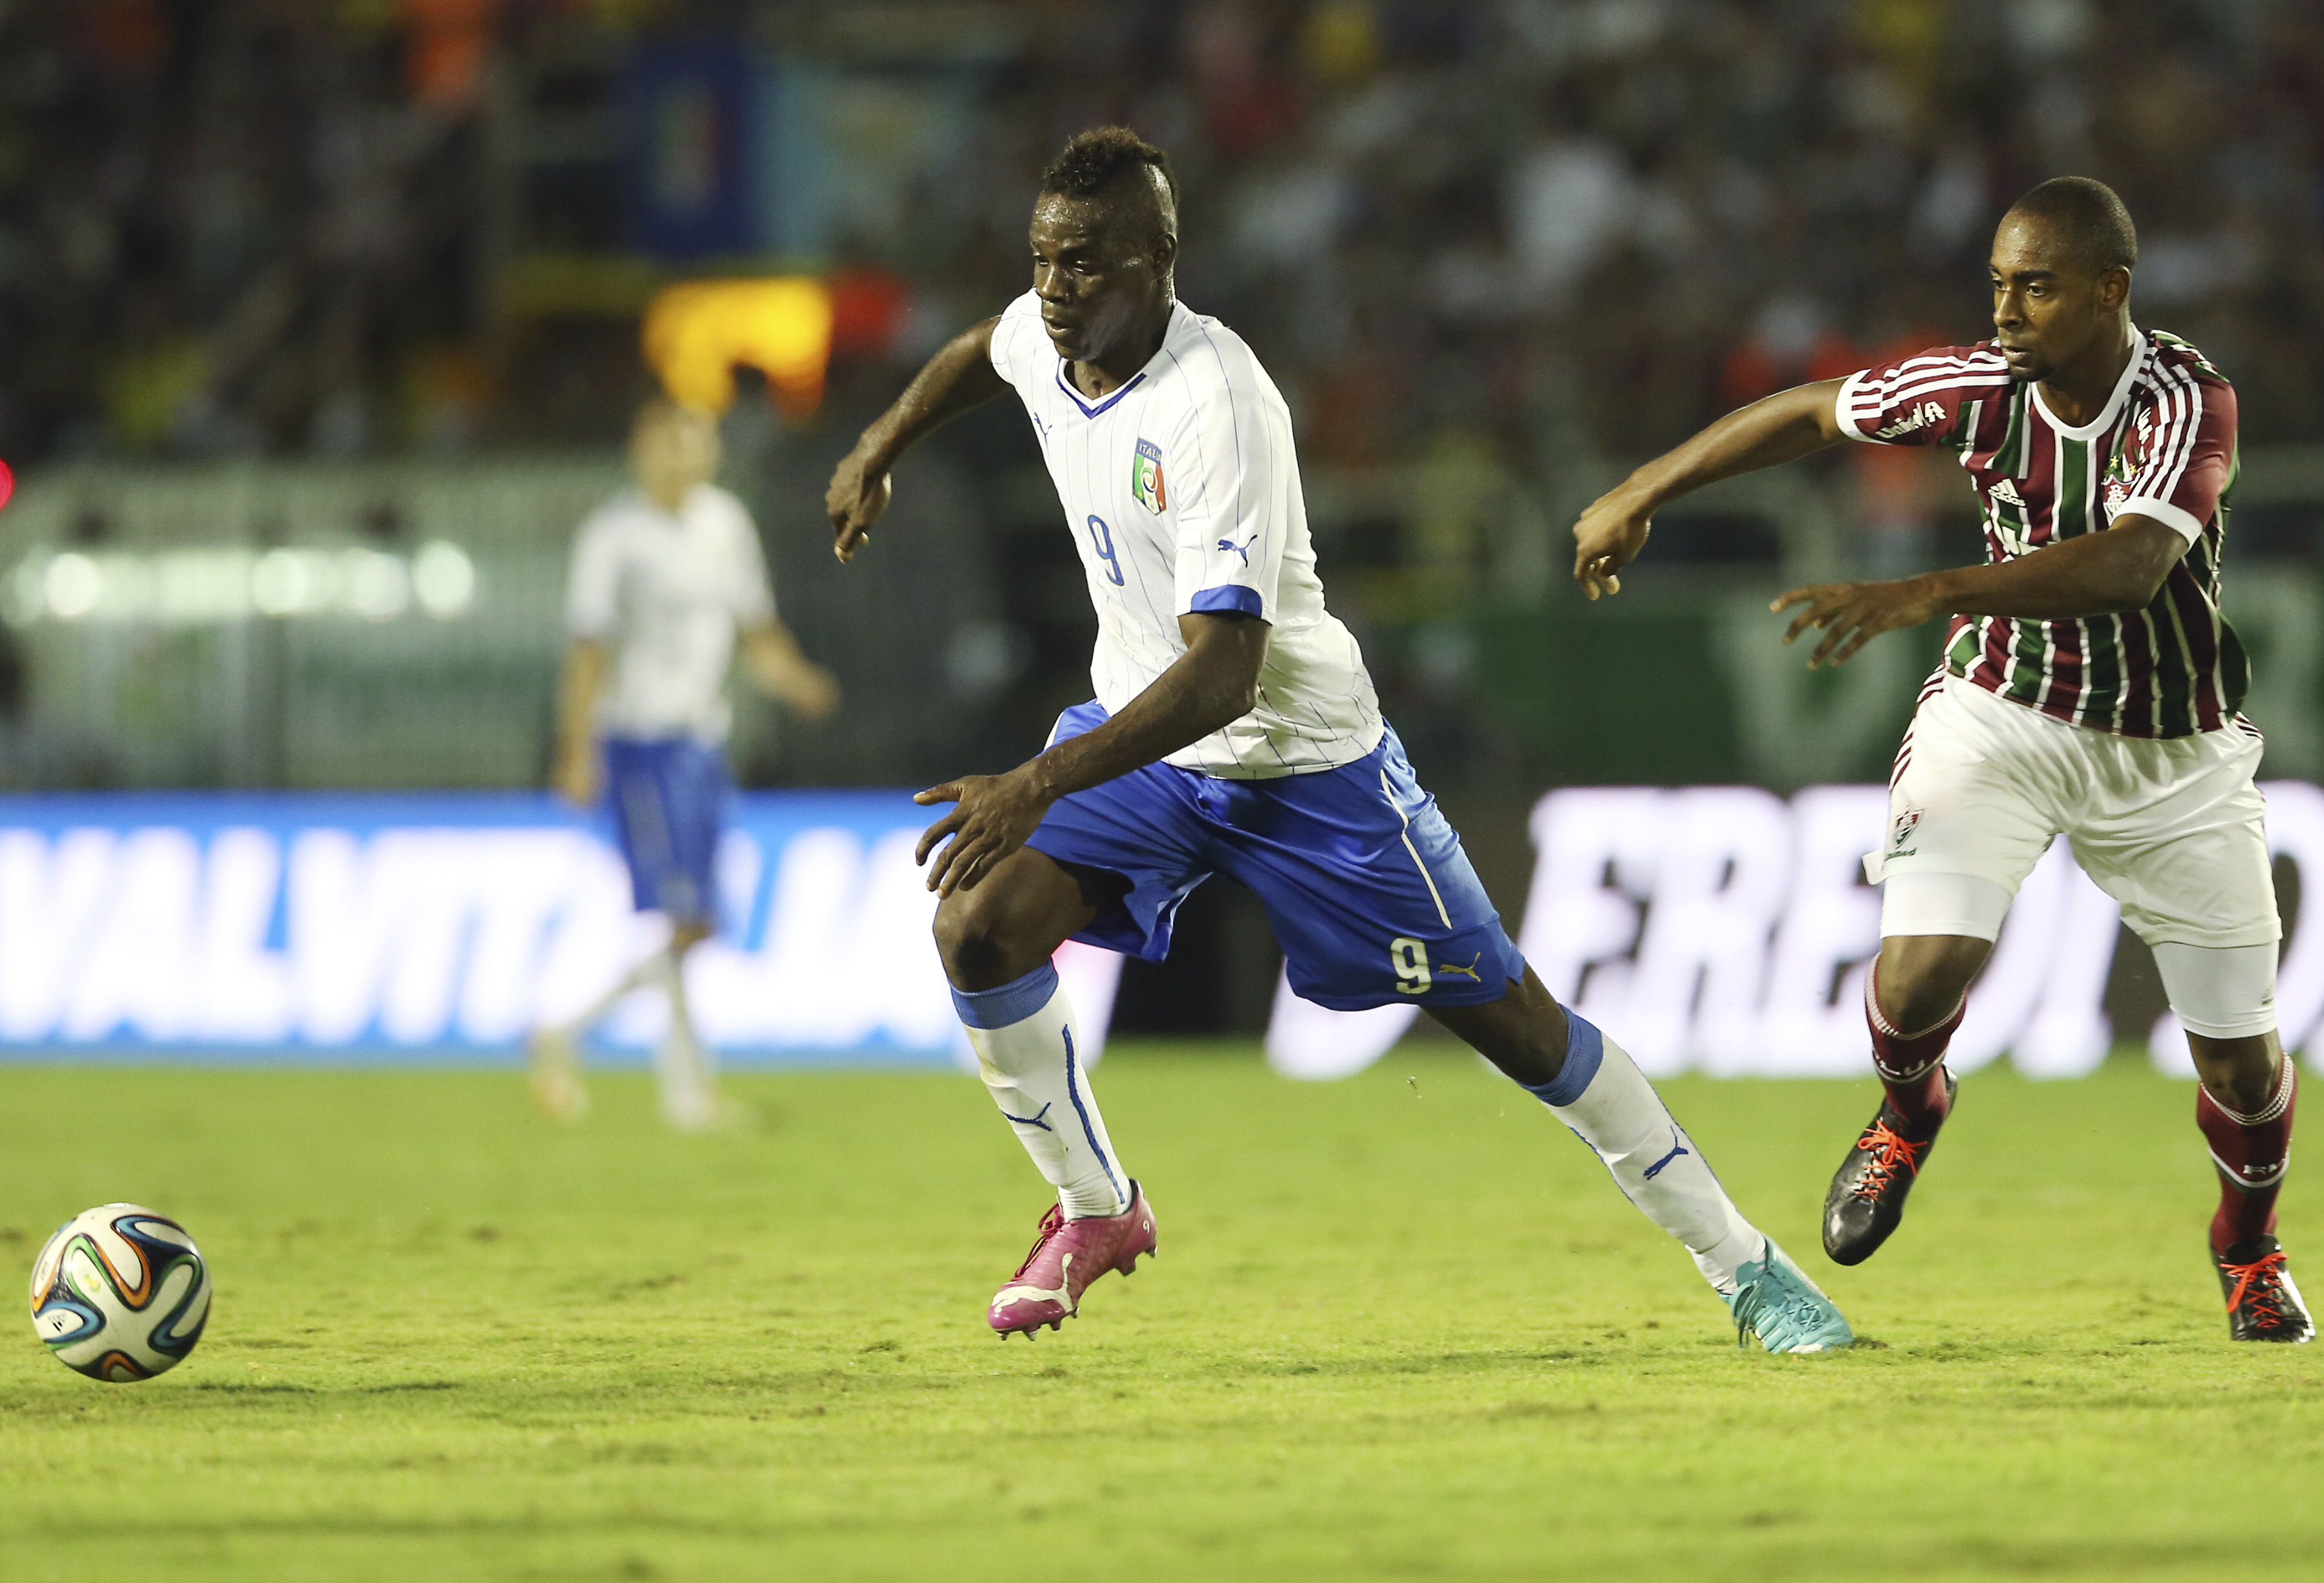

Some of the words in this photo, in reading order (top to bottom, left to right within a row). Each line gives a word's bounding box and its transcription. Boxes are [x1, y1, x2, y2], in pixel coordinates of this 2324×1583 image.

[1139, 442, 1162, 462] ITALIA
[1088, 515, 1124, 586] 9
[1390, 938, 1432, 995] 9
[1143, 1220, 1150, 1234] 9
